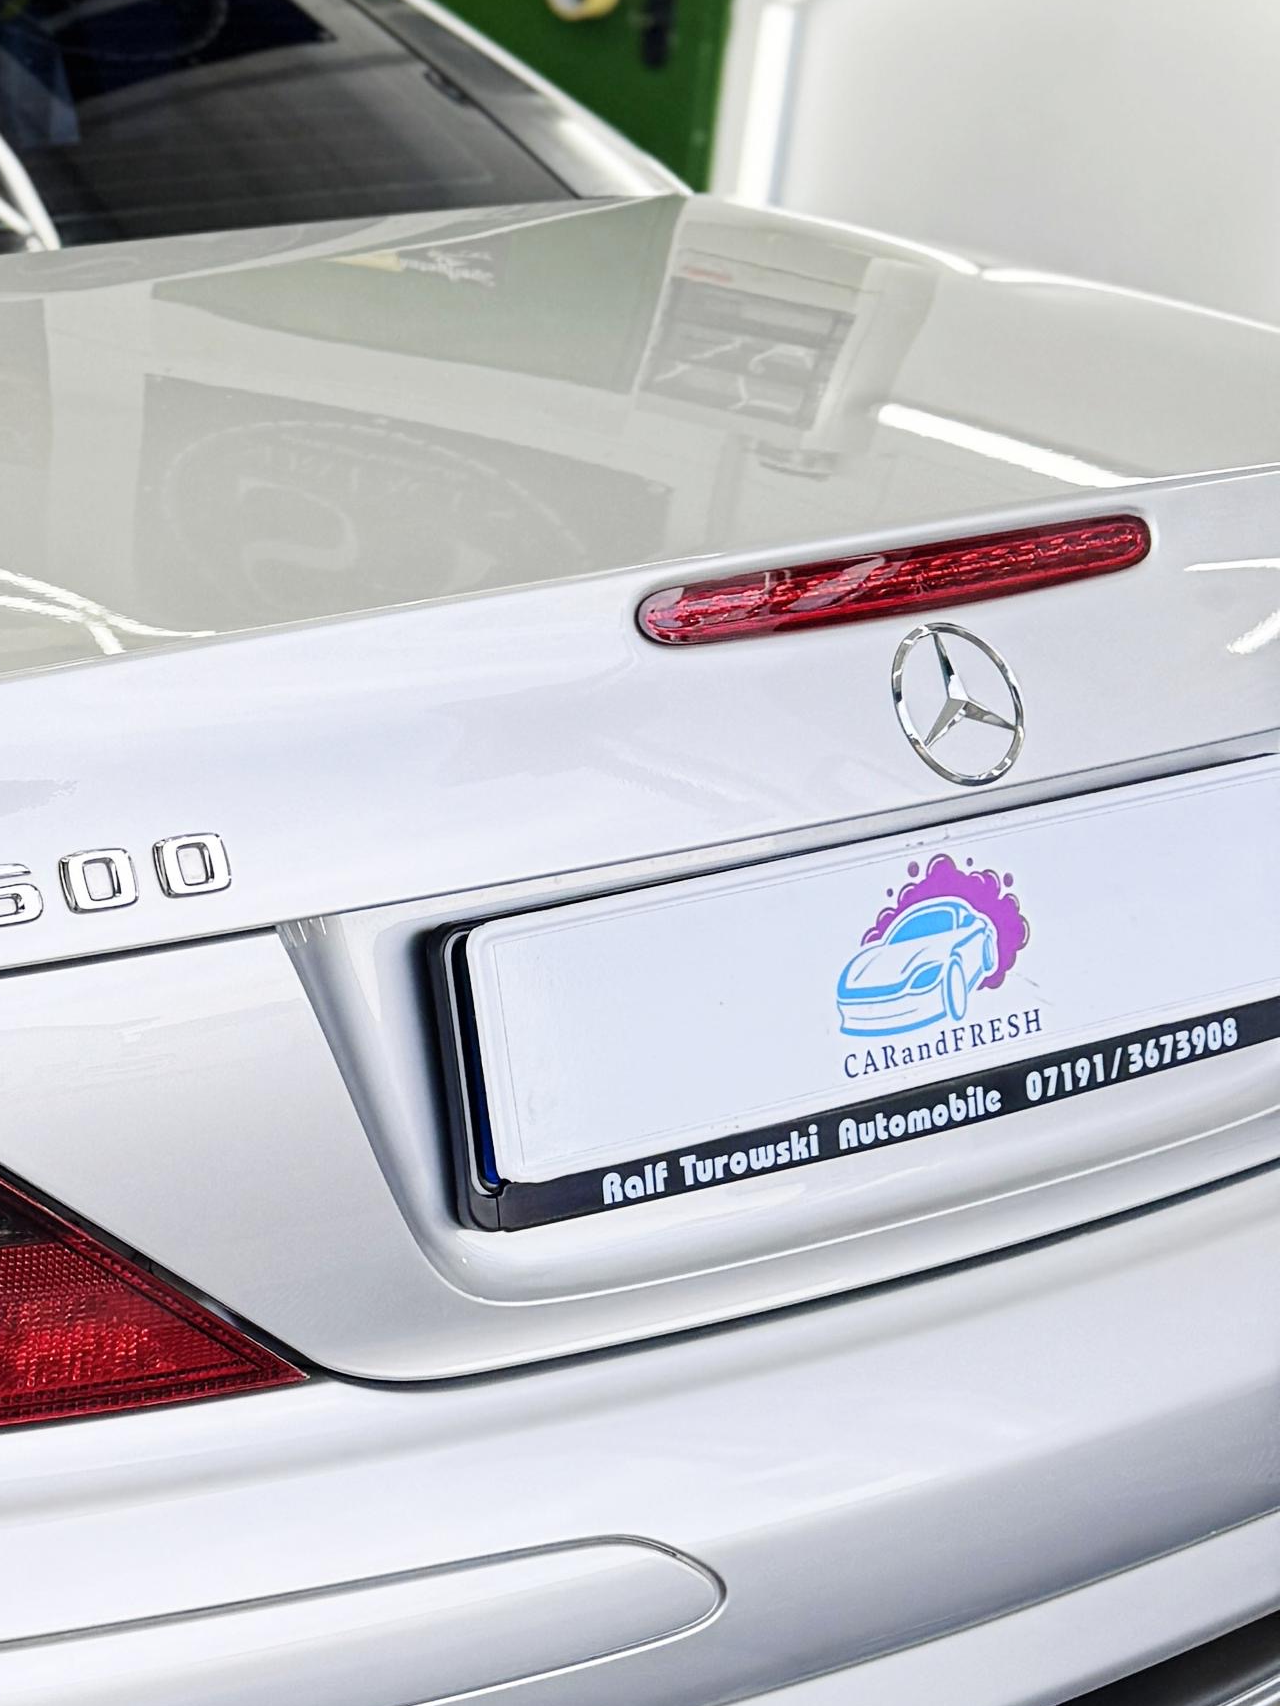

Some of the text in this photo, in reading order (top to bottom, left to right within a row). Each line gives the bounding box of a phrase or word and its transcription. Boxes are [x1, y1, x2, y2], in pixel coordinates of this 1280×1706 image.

[844, 1008, 1044, 1080] CARandFRESH
[602, 1017, 1238, 1204] Ralf Turowski Automobile 07191/3673908
